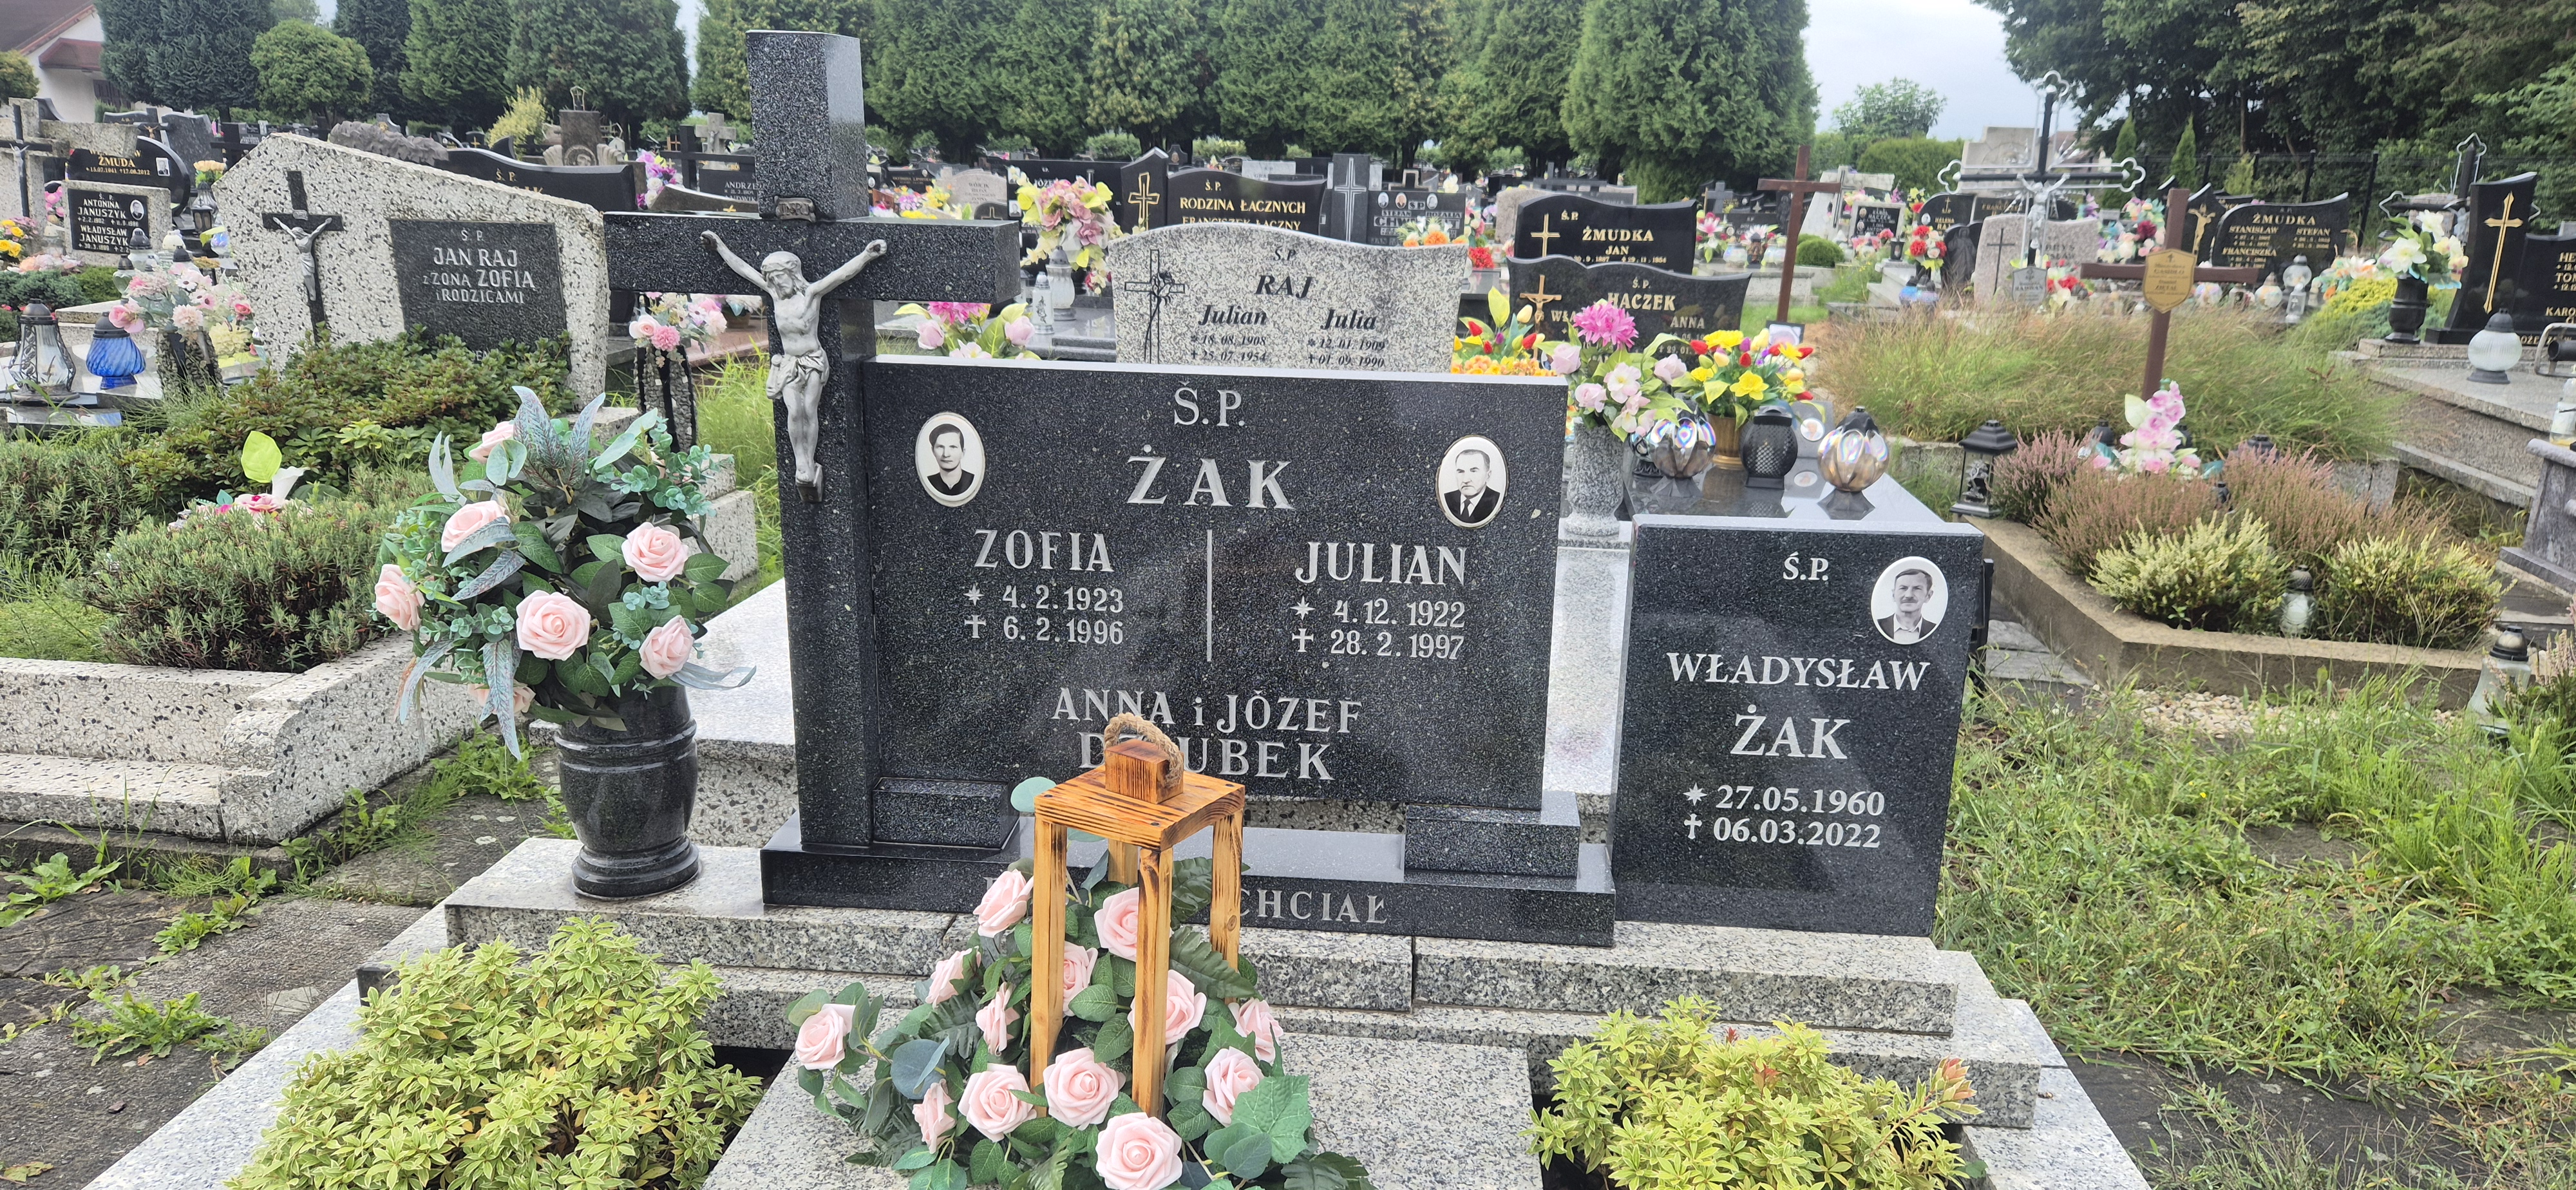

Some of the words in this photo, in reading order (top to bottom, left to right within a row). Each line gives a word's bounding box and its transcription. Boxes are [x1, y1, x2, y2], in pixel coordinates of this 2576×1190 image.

[98, 155, 136, 168] ŻMUDA
[77, 206, 127, 220] JANUSZYK
[82, 198, 120, 209] ANTONINA
[1179, 196, 1235, 211] RODZINA
[2251, 212, 2316, 226] ŻMUDKA
[79, 233, 129, 246] JANUSZYK
[80, 225, 127, 236] WŁADYSŁAW
[1582, 225, 1654, 242] ŻMUDKA
[433, 247, 473, 266] JAN
[478, 248, 518, 267] RAJ
[1605, 245, 1629, 255] JAN
[1255, 274, 1312, 299] RAJ
[440, 288, 526, 305] RODZICAMI
[1607, 292, 1676, 311] HACZEK
[1197, 304, 1268, 326] Julian
[1320, 308, 1378, 331] Julia
[1670, 316, 1705, 329] ANNA
[1126, 444, 1294, 509] ŻAK
[974, 529, 1115, 572] ZOFIA
[1294, 541, 1468, 587] JULIAN
[1666, 652, 1931, 692] WŁADYSŁAW
[1050, 687, 1176, 725] ANNA
[1192, 697, 1206, 726] i
[1216, 690, 1363, 734] JÓZEF
[1730, 704, 1851, 760] ŻAK
[1077, 732, 1336, 780] DUBEK
[1715, 784, 1885, 816] 27.05.1960
[1713, 817, 1881, 849] 06.03.2022
